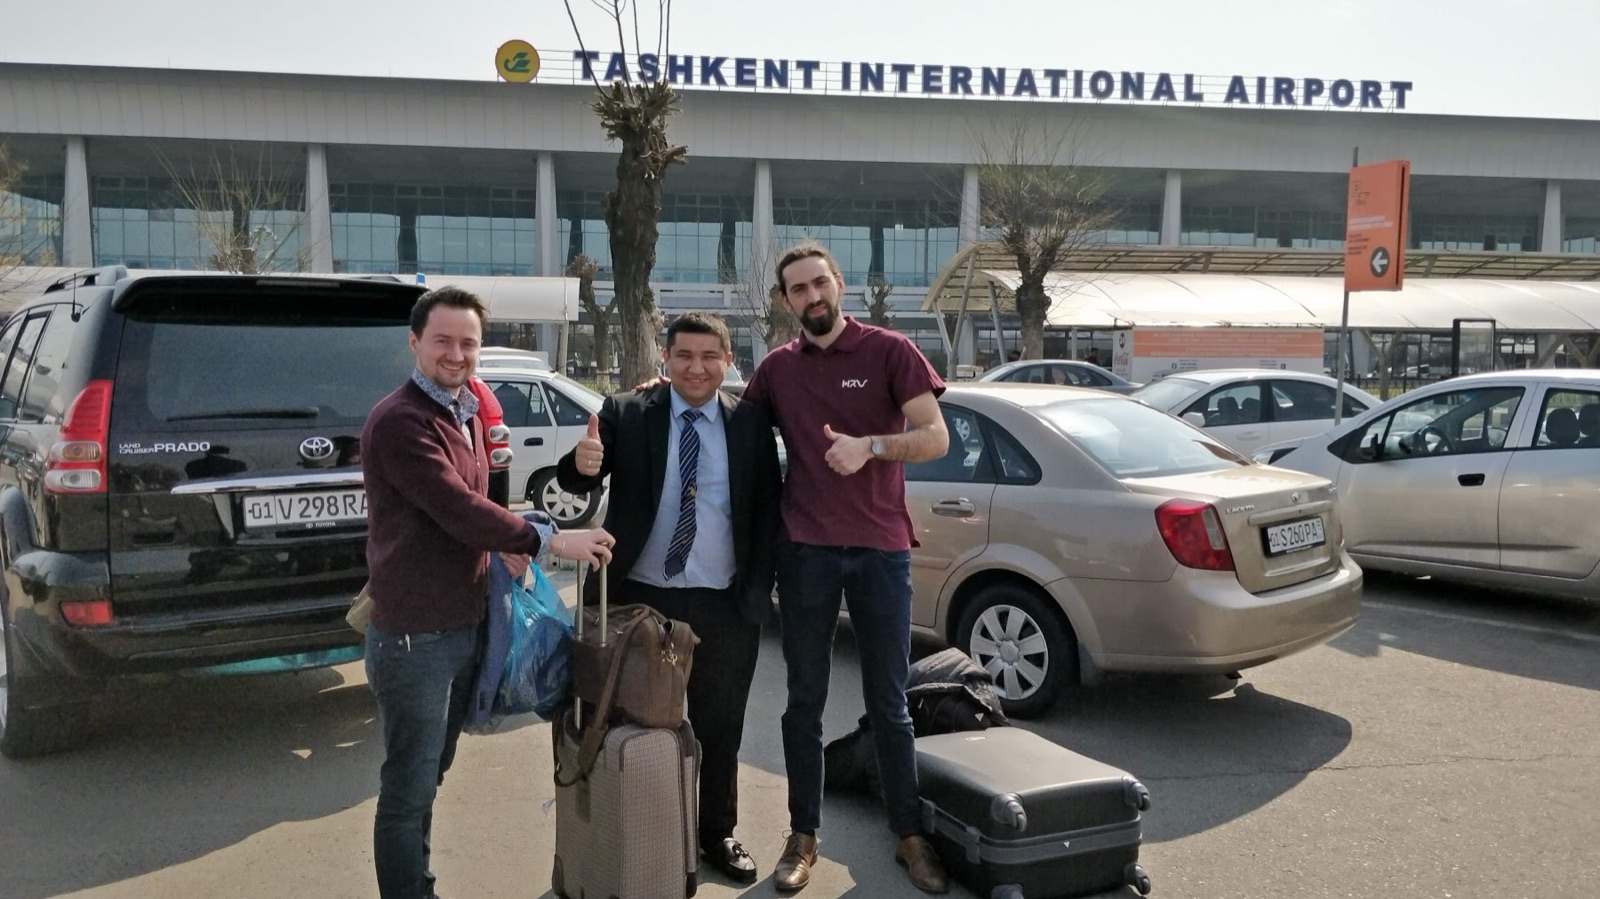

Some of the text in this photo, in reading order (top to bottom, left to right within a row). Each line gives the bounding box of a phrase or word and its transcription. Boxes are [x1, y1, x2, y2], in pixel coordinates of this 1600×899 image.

[574, 50, 1413, 109] TASHKENT INTERNATIONAL AIRPORT
[154, 441, 211, 453] PRADO
